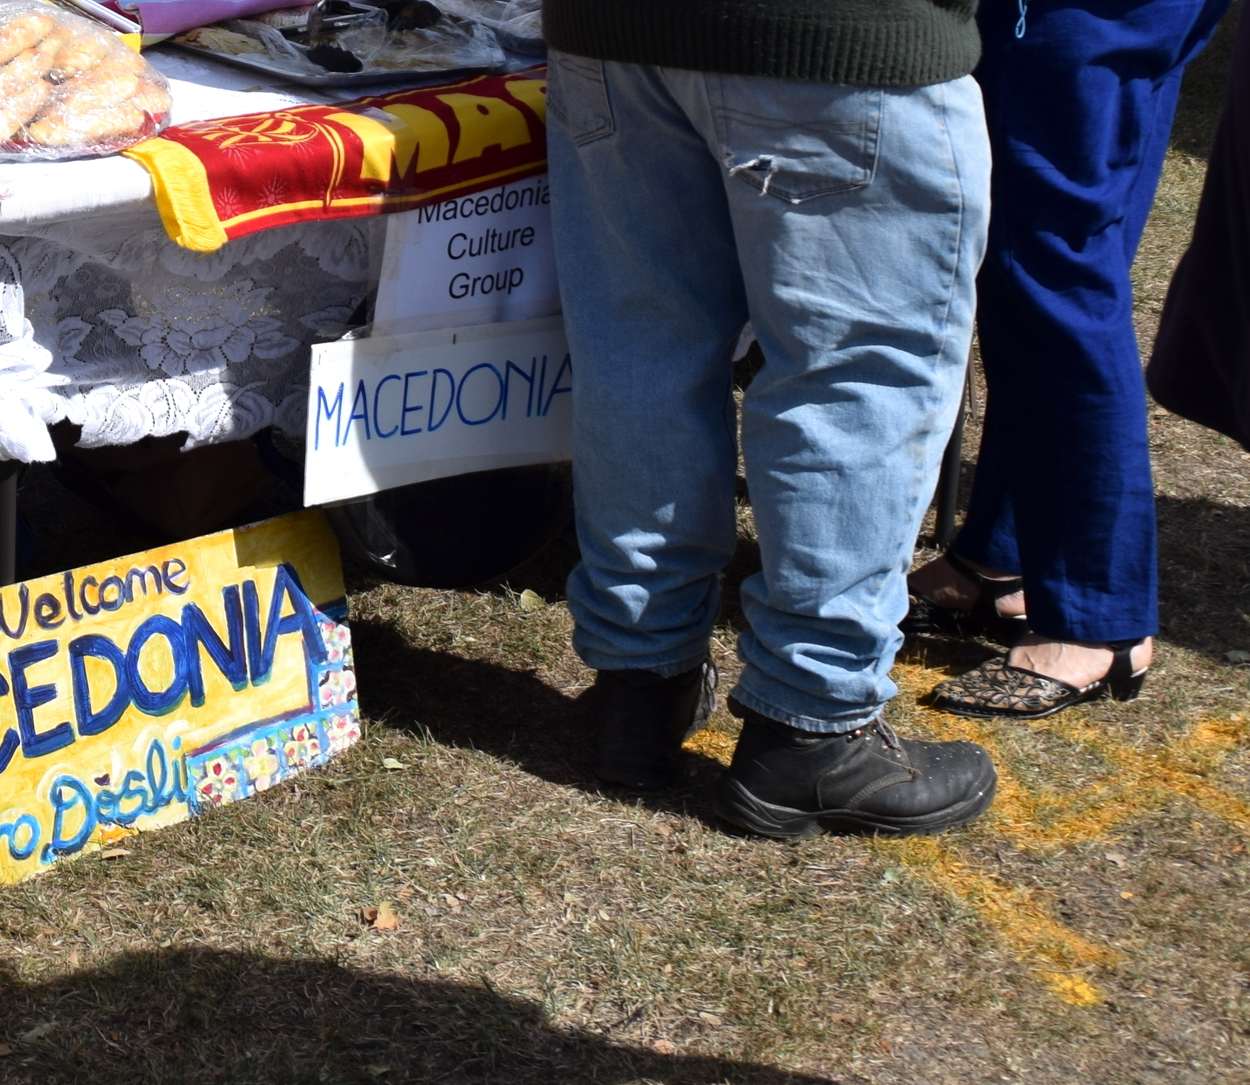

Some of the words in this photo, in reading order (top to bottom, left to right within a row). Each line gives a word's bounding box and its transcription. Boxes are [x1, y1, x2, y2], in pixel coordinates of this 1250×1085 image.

[447, 223, 535, 261] Culture
[449, 263, 524, 300] Group
[314, 353, 573, 451] MACEDONIA
